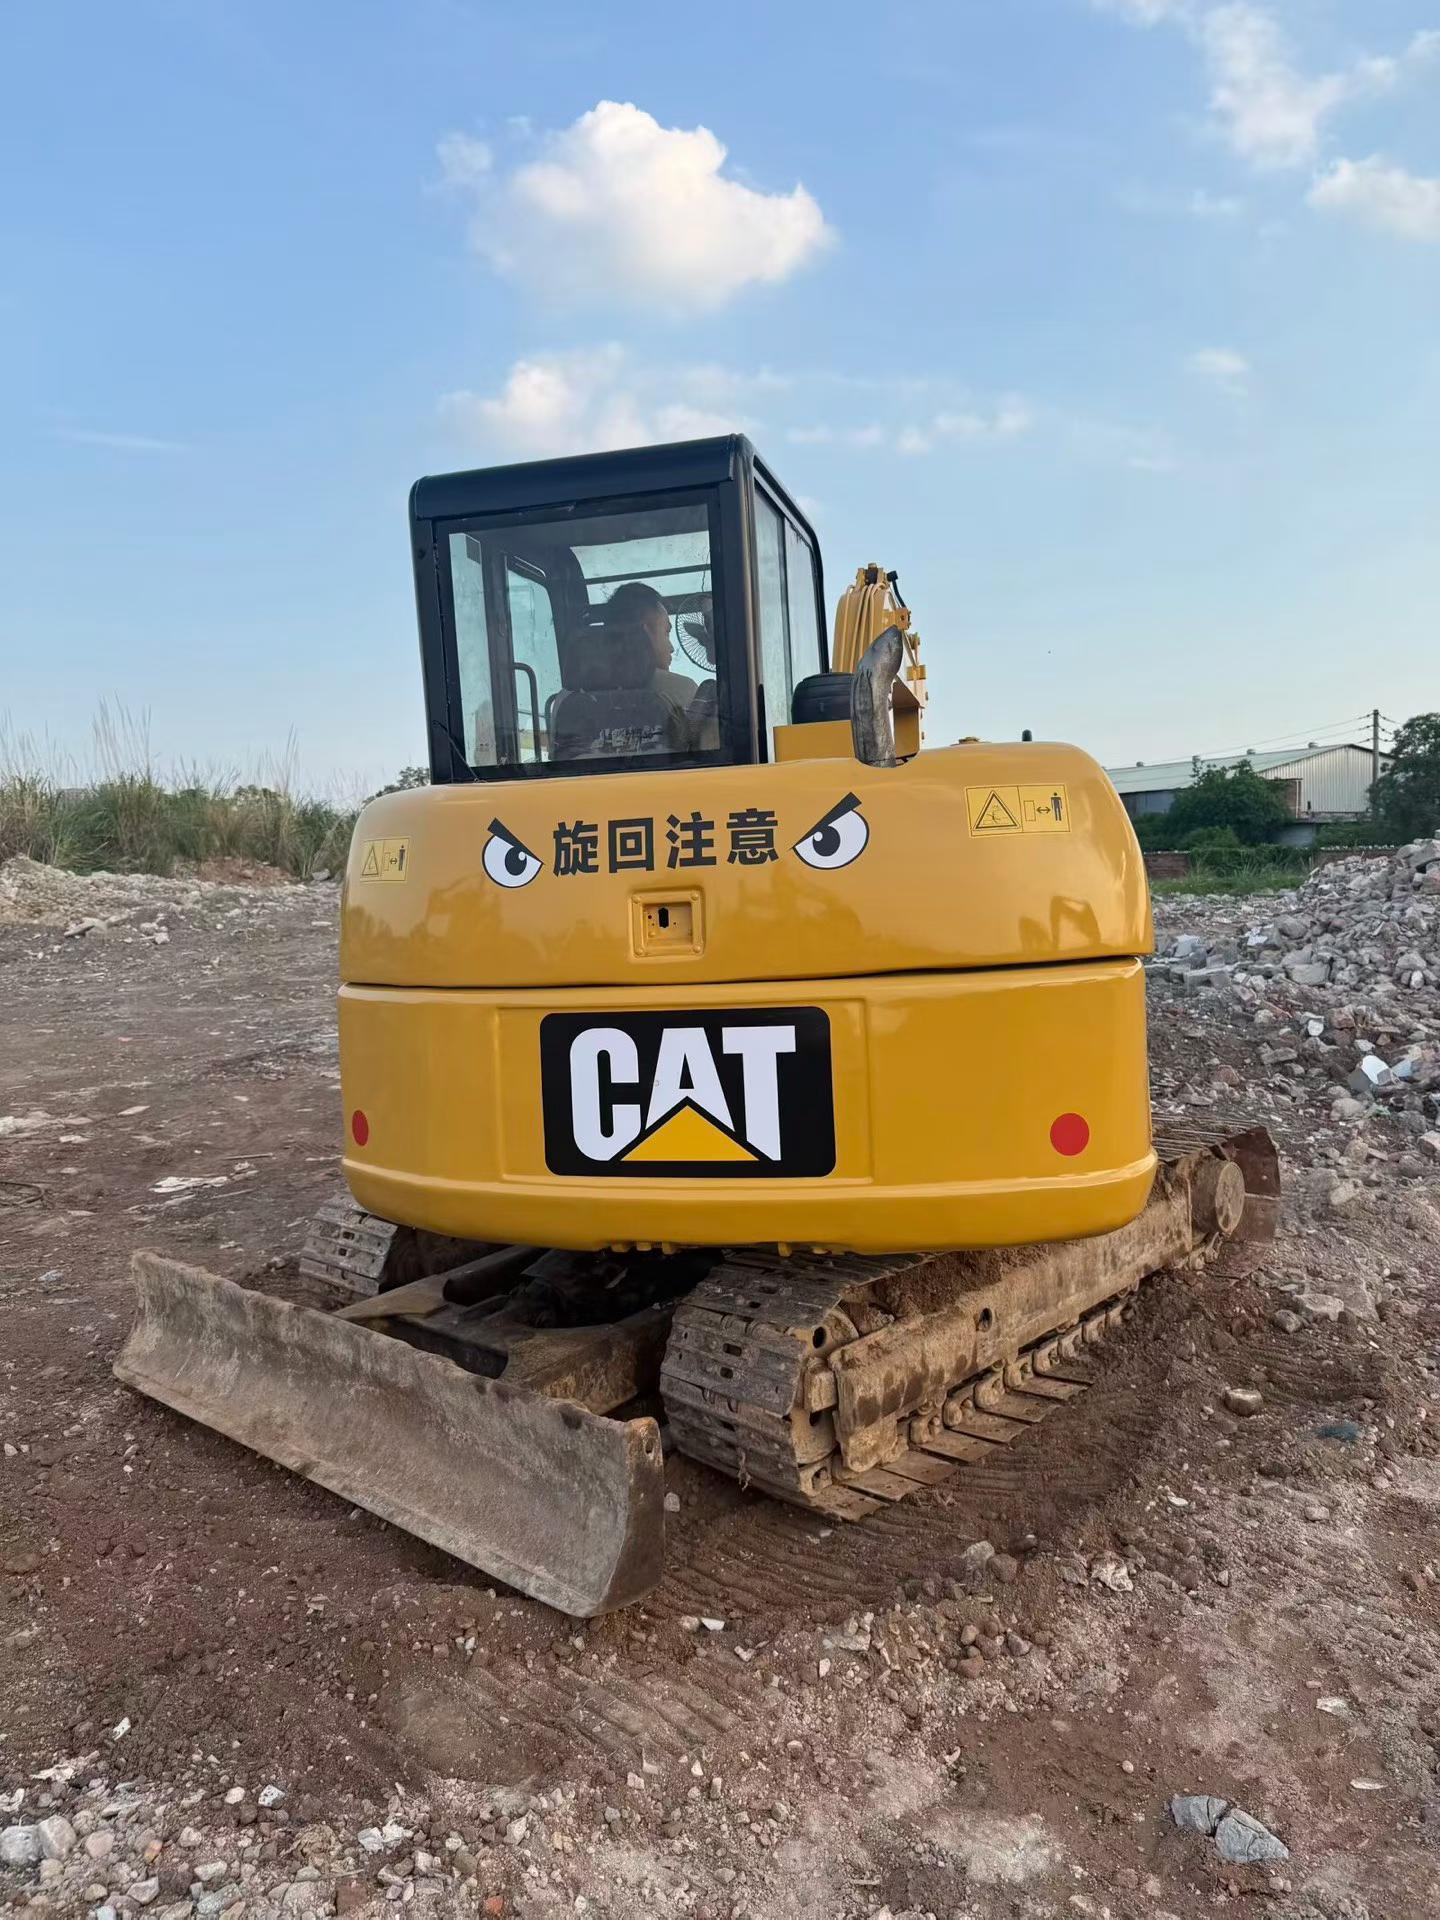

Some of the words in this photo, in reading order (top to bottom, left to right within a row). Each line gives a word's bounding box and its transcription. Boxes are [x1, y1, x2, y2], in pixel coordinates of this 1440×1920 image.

[553, 808, 779, 877] 旋回注意
[570, 1025, 796, 1161] CAT
